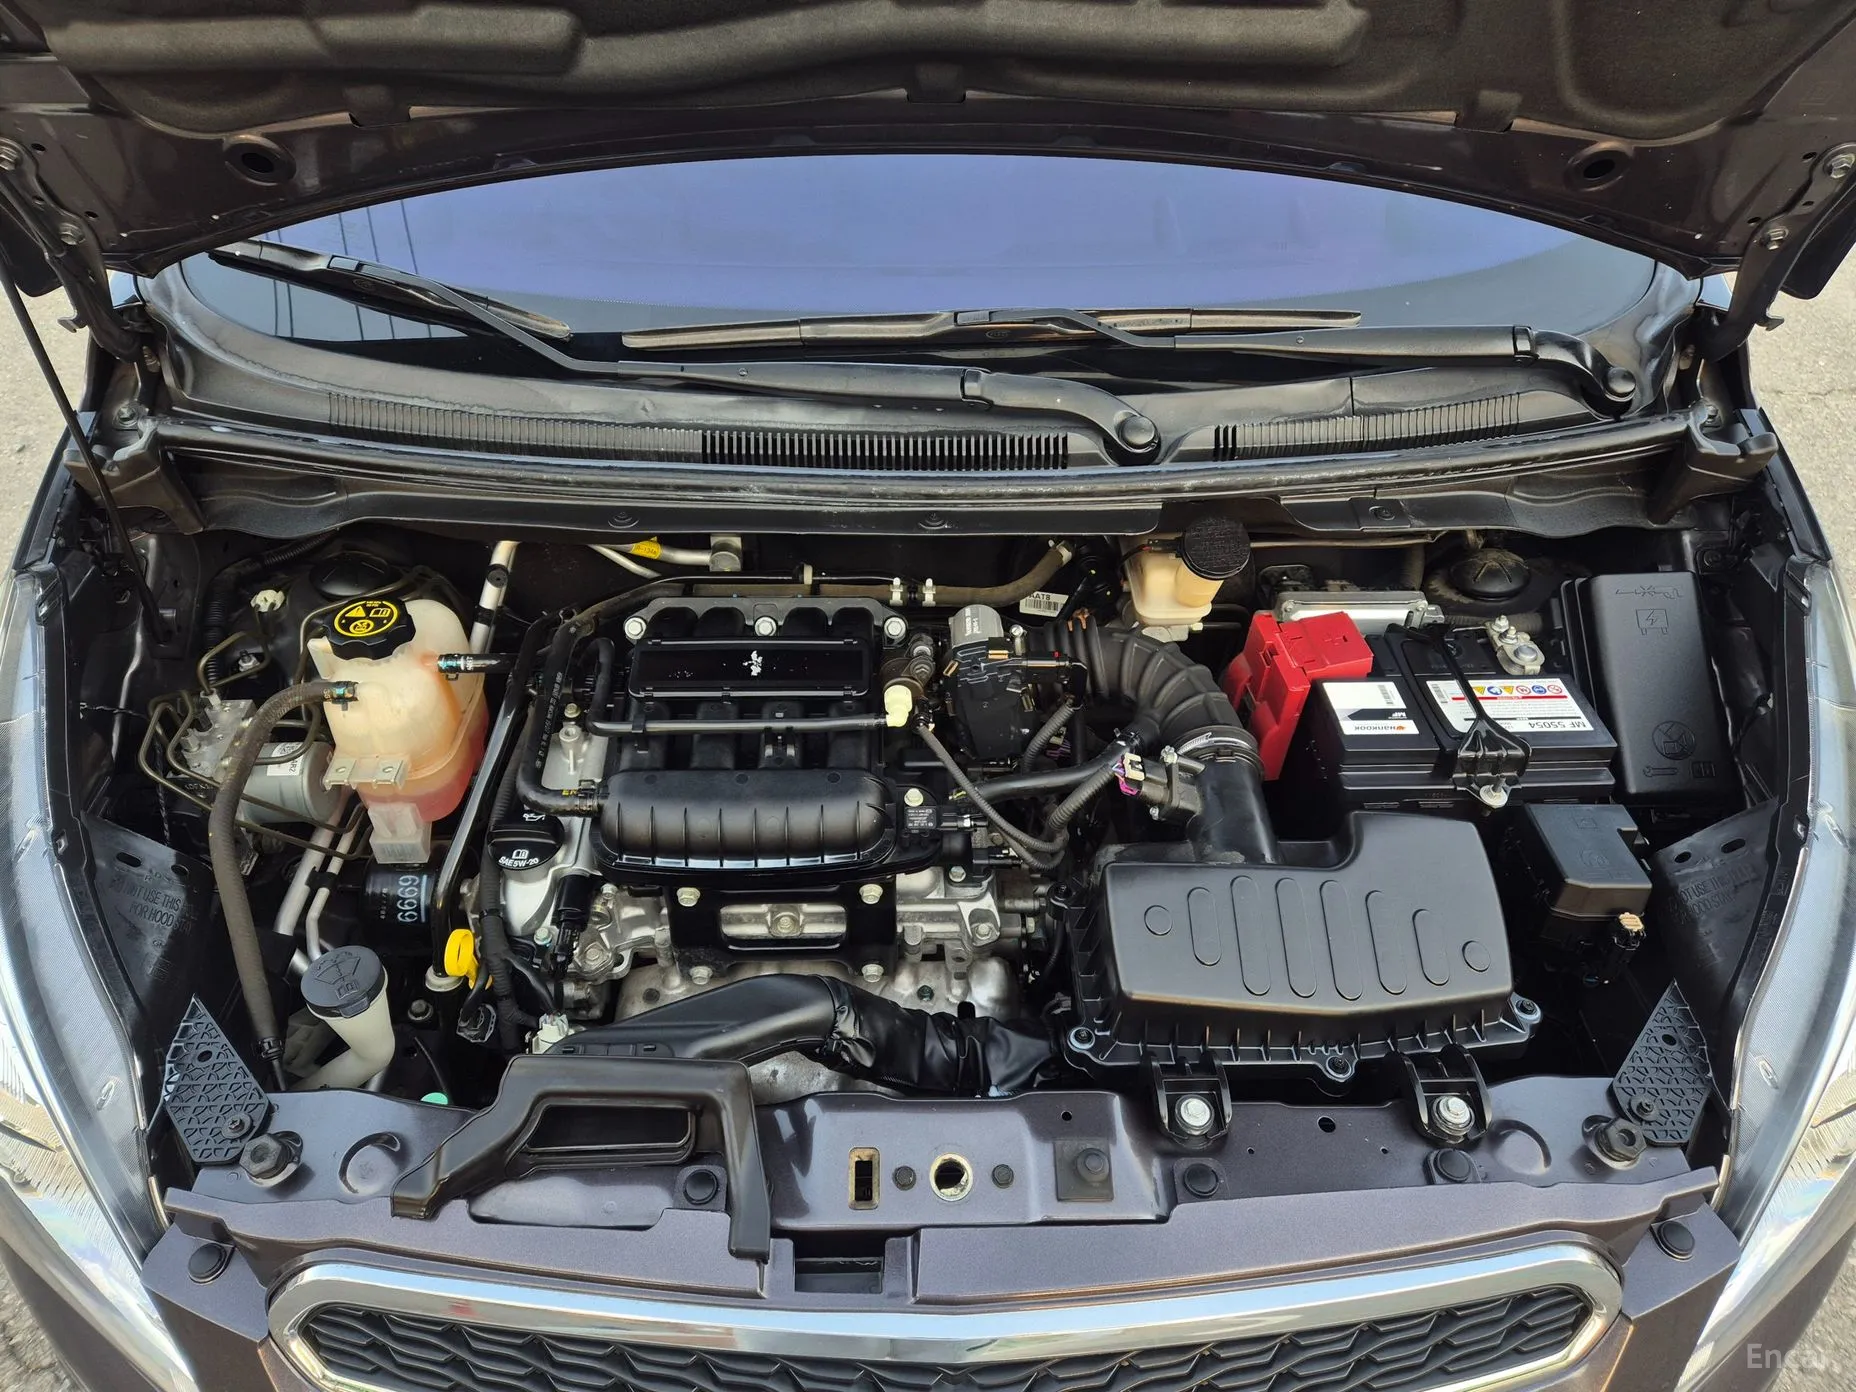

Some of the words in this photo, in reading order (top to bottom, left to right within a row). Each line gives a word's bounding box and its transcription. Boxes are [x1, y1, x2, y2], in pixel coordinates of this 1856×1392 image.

[1528, 721, 1565, 729] 55054
[1567, 721, 1586, 729] MF
[142, 886, 161, 905] USE
[160, 893, 181, 912] THIS
[147, 910, 174, 928] HOOD
